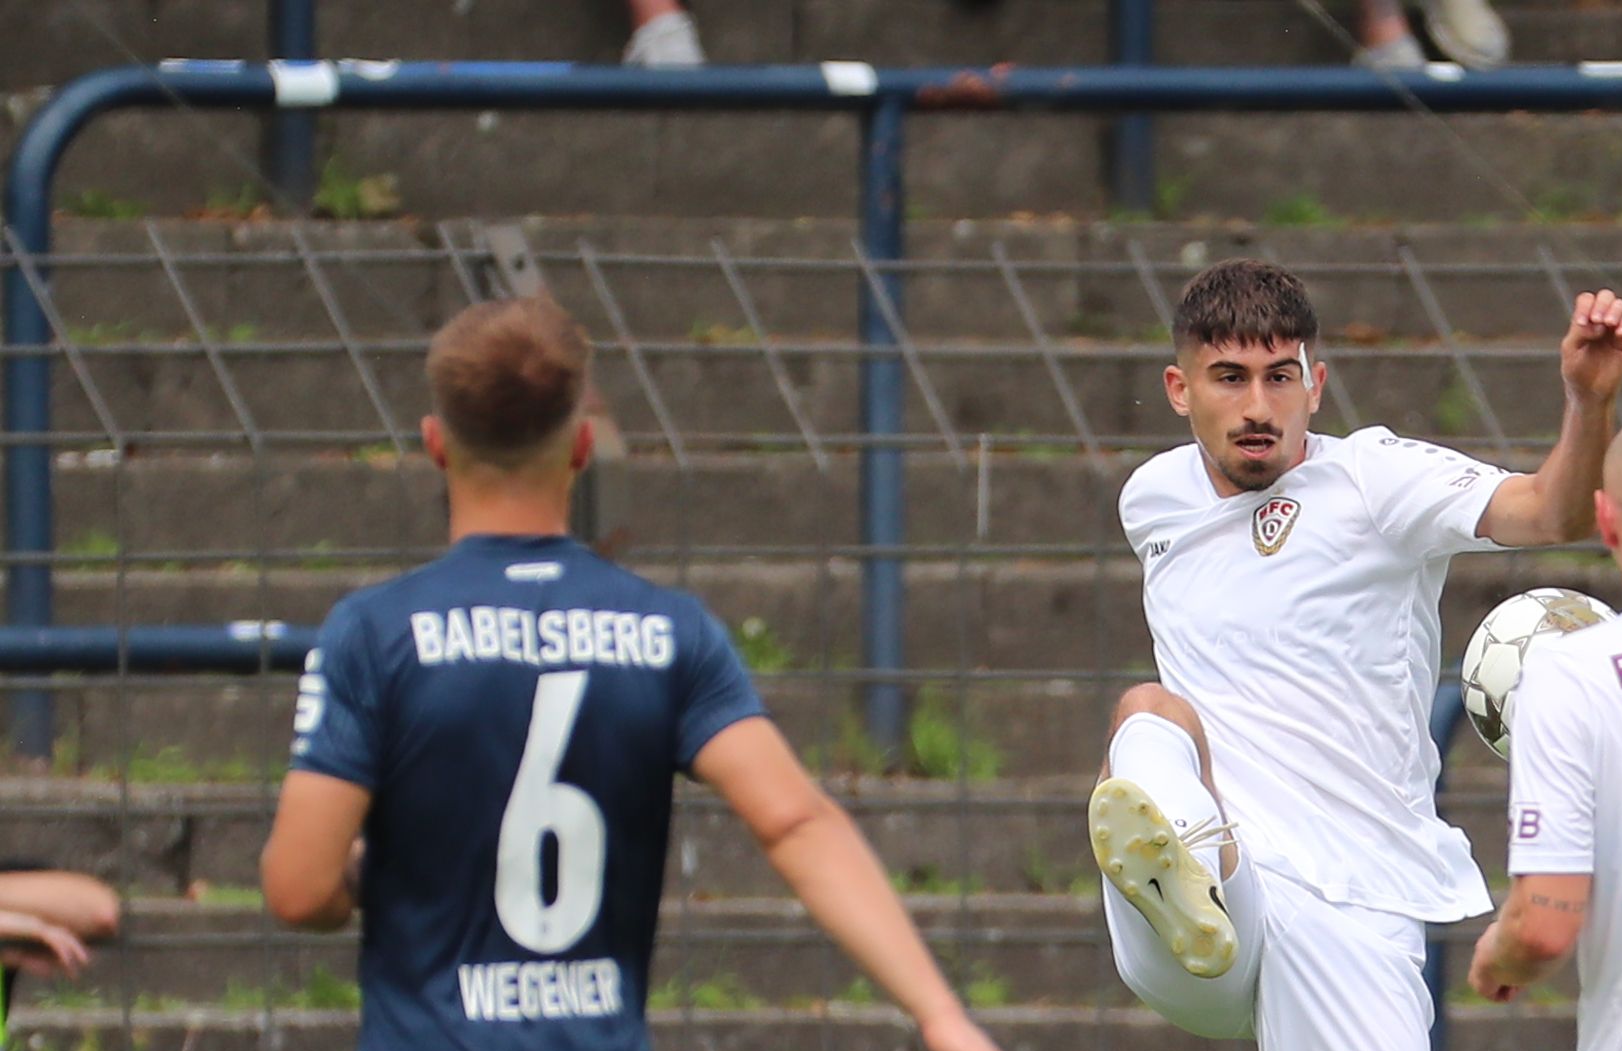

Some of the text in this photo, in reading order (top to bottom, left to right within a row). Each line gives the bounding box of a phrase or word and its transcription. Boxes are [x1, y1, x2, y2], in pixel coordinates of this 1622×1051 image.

[410, 606, 675, 668] BABELSBERG
[494, 669, 607, 955] 6
[458, 957, 623, 1021] WEGENER
